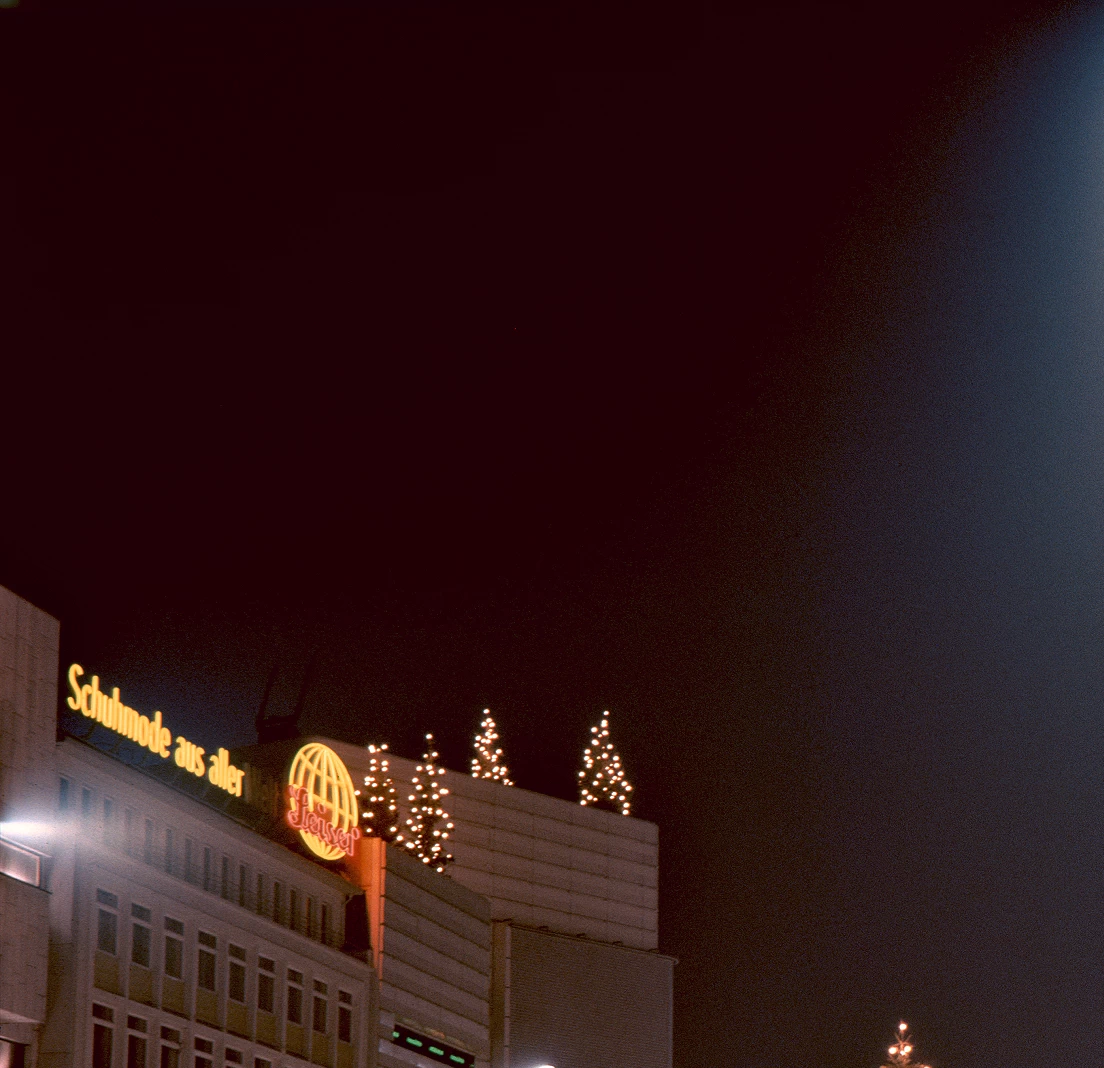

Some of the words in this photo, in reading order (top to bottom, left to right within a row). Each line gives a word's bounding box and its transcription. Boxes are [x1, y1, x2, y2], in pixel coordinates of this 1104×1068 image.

[67, 663, 172, 758] Schuhmode
[174, 736, 206, 777] aus
[208, 747, 245, 797] aller
[287, 784, 361, 856] Leiser
